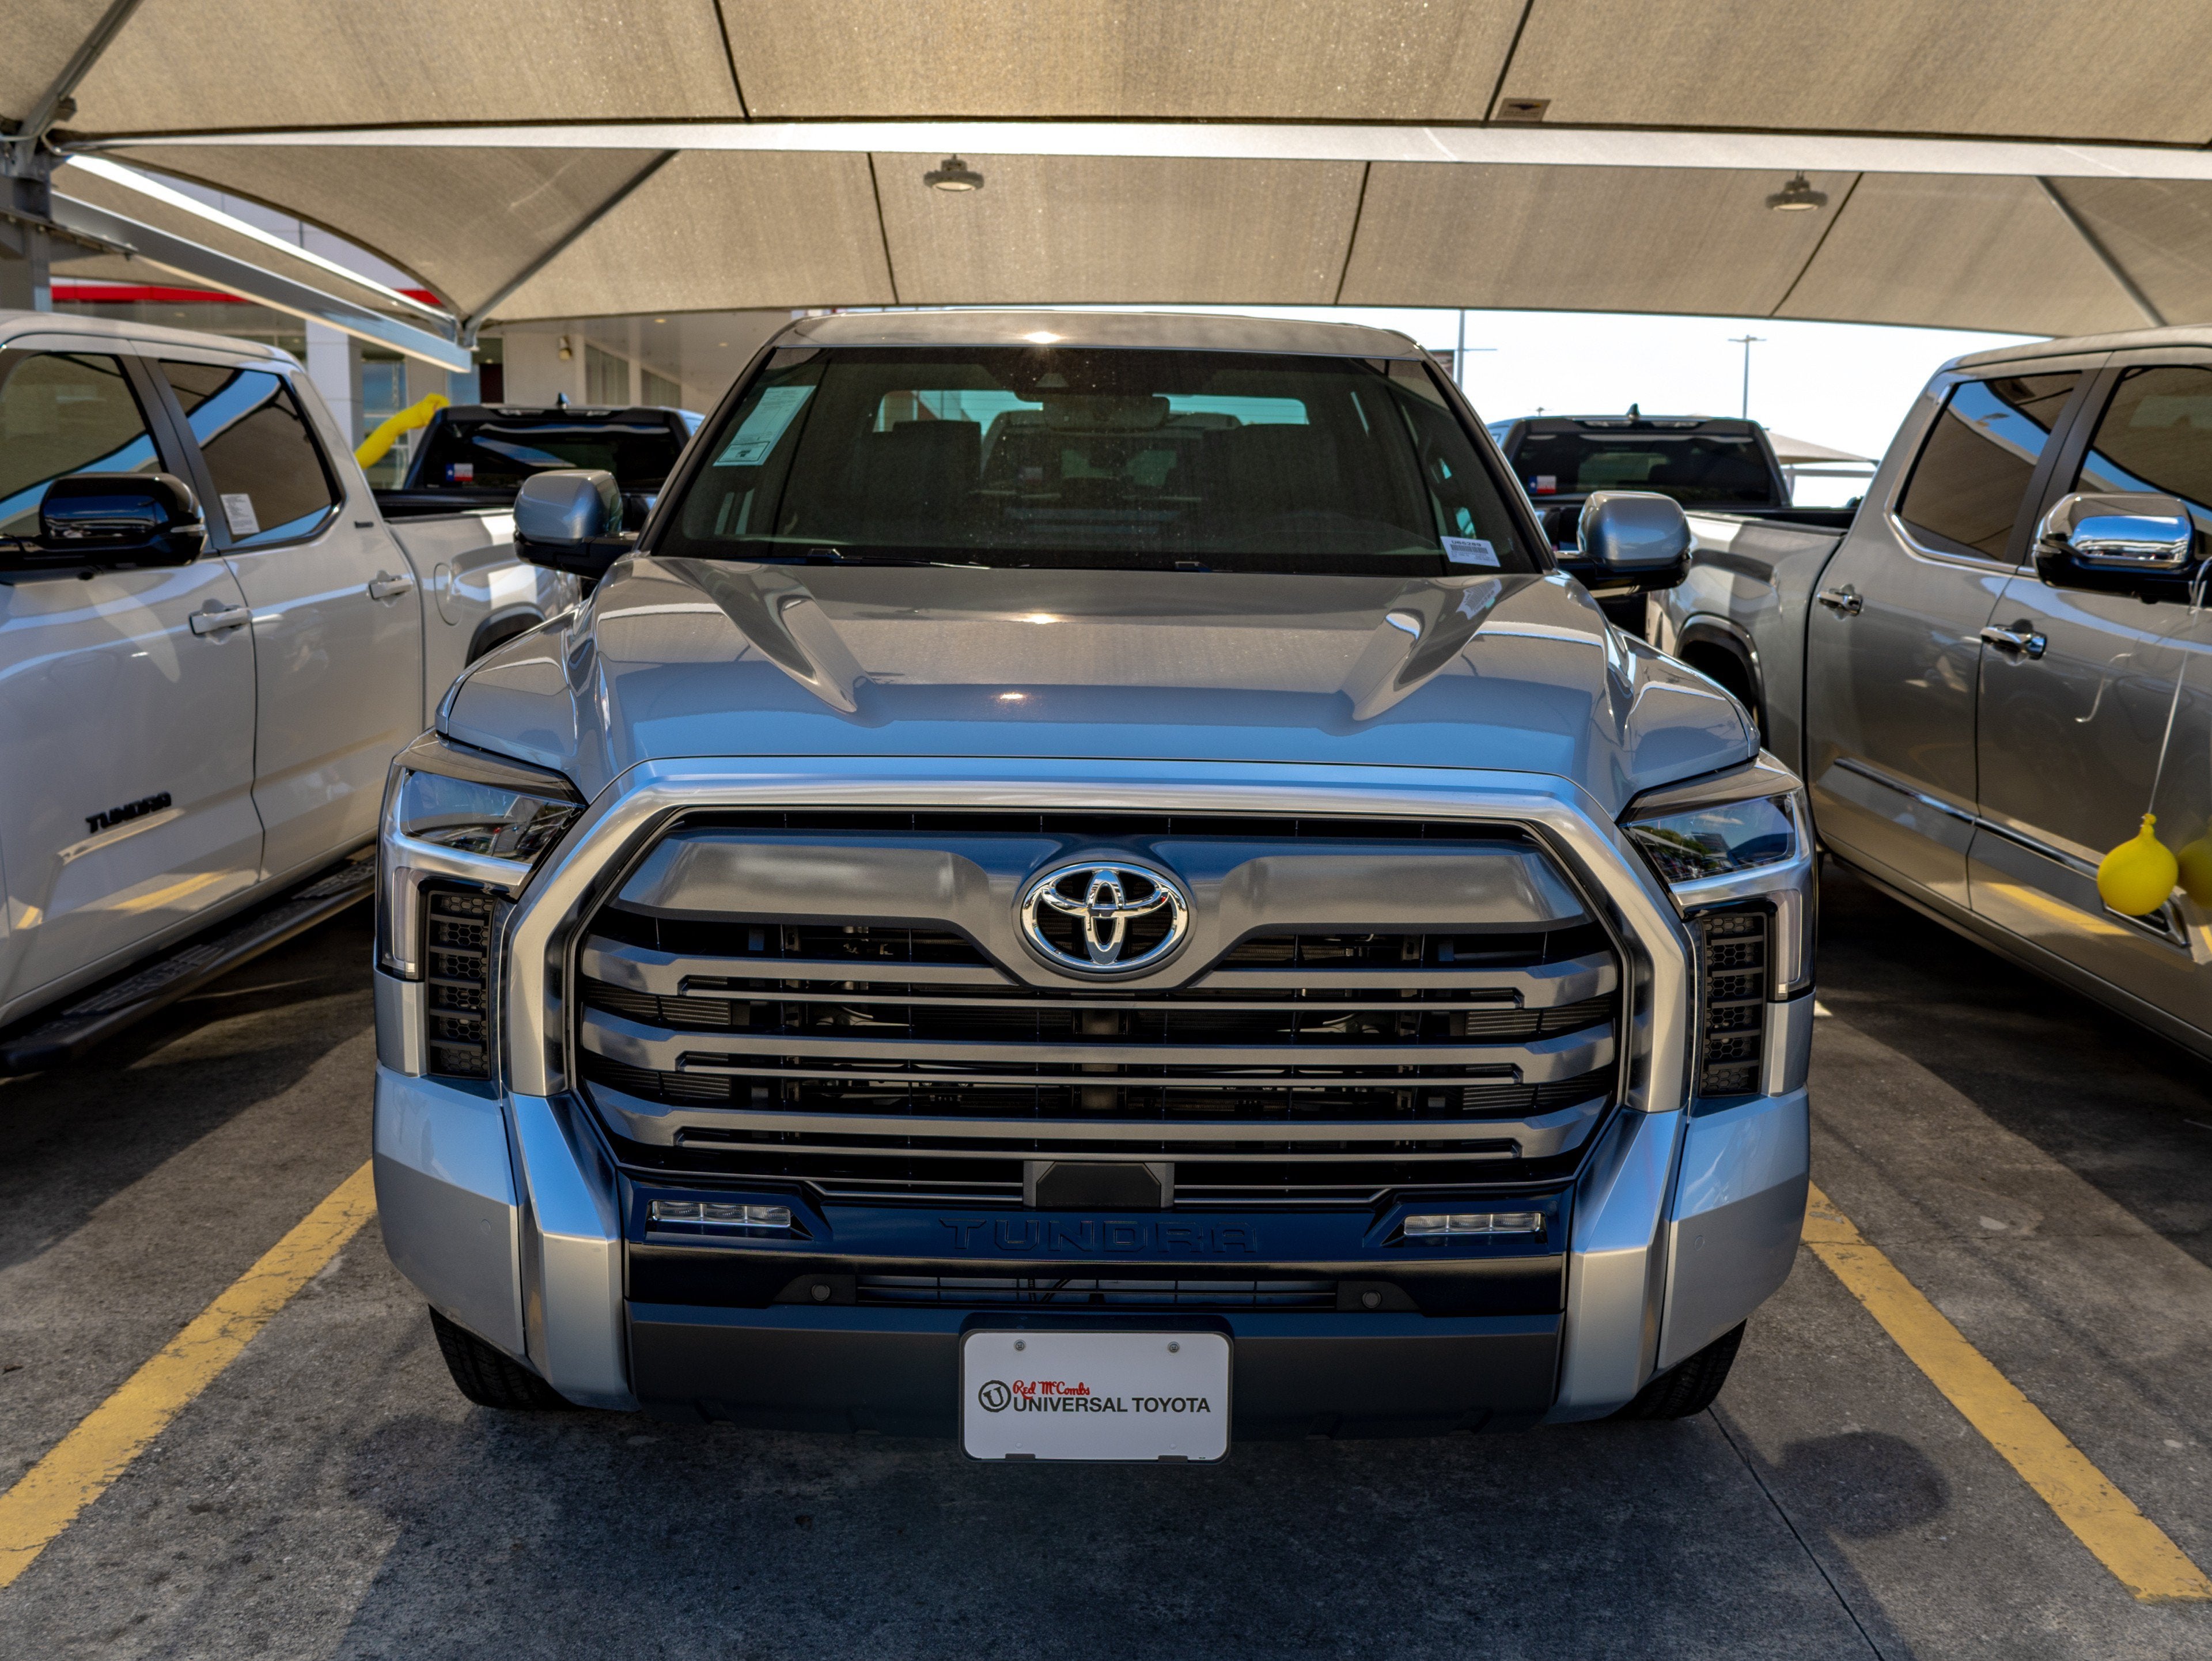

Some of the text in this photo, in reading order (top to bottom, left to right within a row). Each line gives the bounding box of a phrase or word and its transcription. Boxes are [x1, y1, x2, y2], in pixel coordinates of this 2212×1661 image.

[85, 791, 172, 834] TUNDRA
[940, 1219, 1257, 1253] TUNDRA
[1013, 1380, 1090, 1399] Red McCombs
[1013, 1397, 1211, 1412] UNIVERSAL TOYOTA
